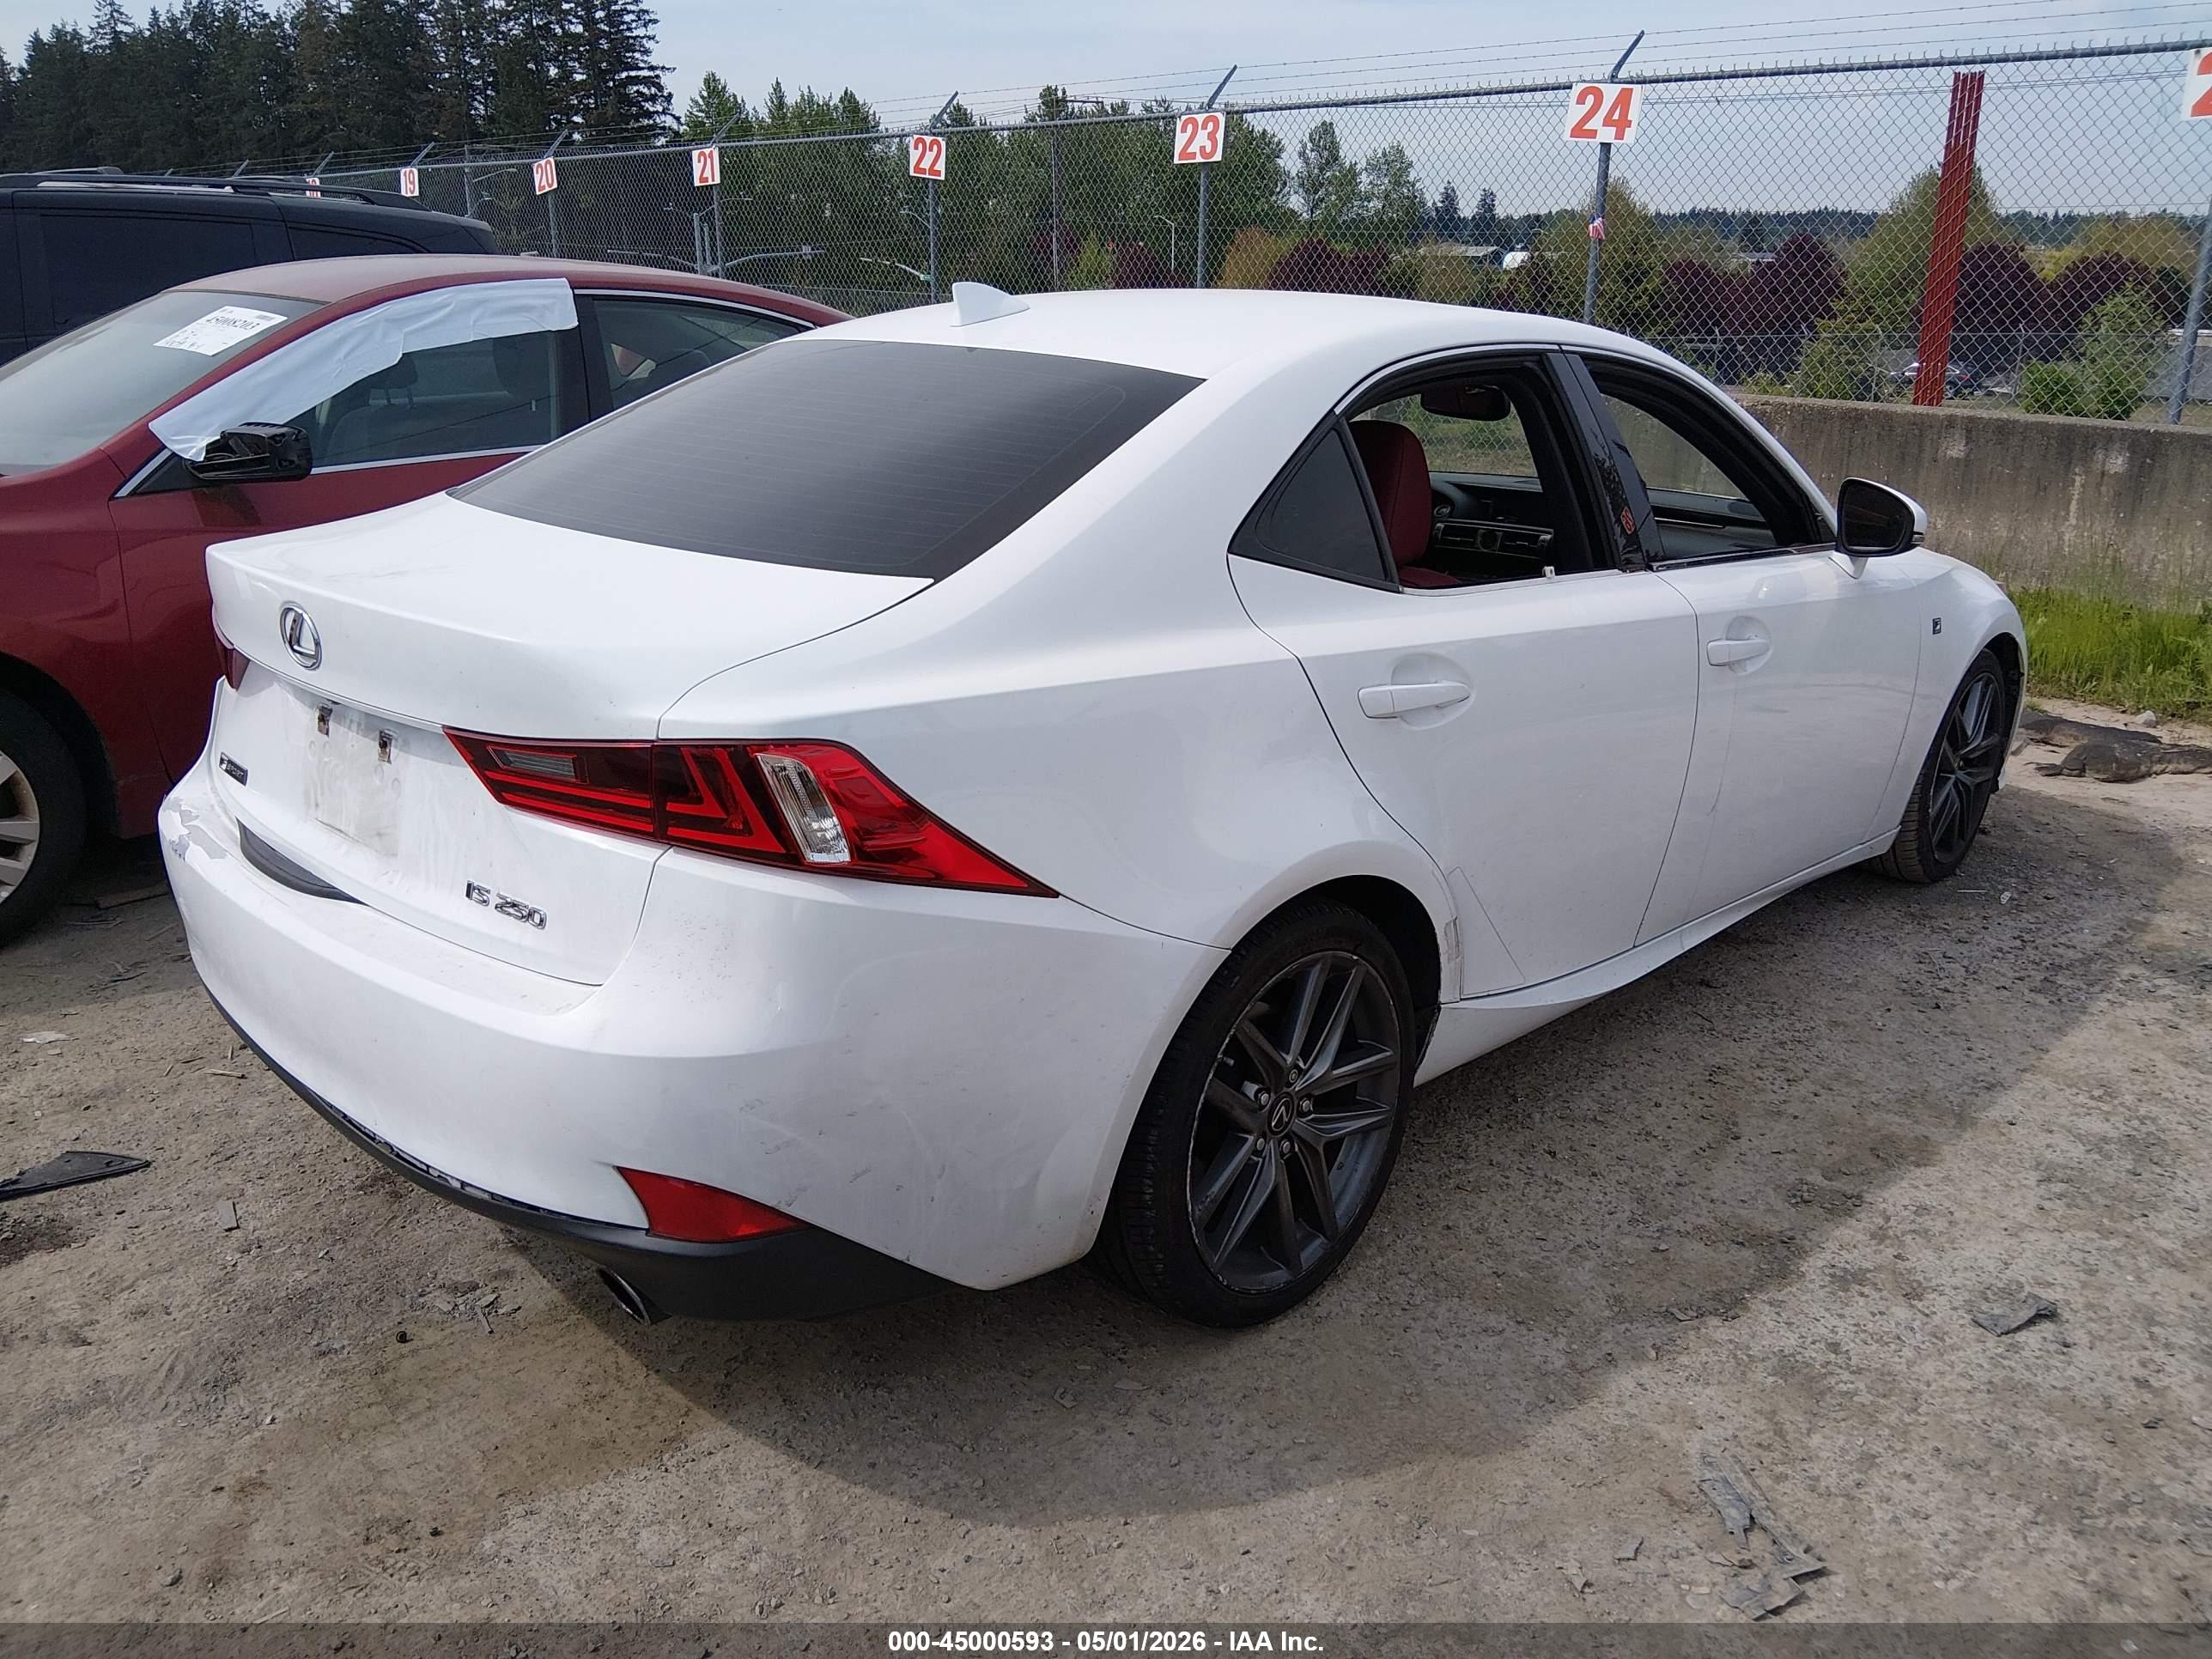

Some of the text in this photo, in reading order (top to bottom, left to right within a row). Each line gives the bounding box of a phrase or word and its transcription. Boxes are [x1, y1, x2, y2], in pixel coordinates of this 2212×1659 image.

[1570, 85, 1633, 141] 24
[911, 136, 944, 178] 22
[1178, 114, 1220, 161] 23
[404, 170, 416, 195] 19
[536, 160, 556, 191] 20
[697, 150, 715, 185] 21
[465, 880, 547, 930] IS 250
